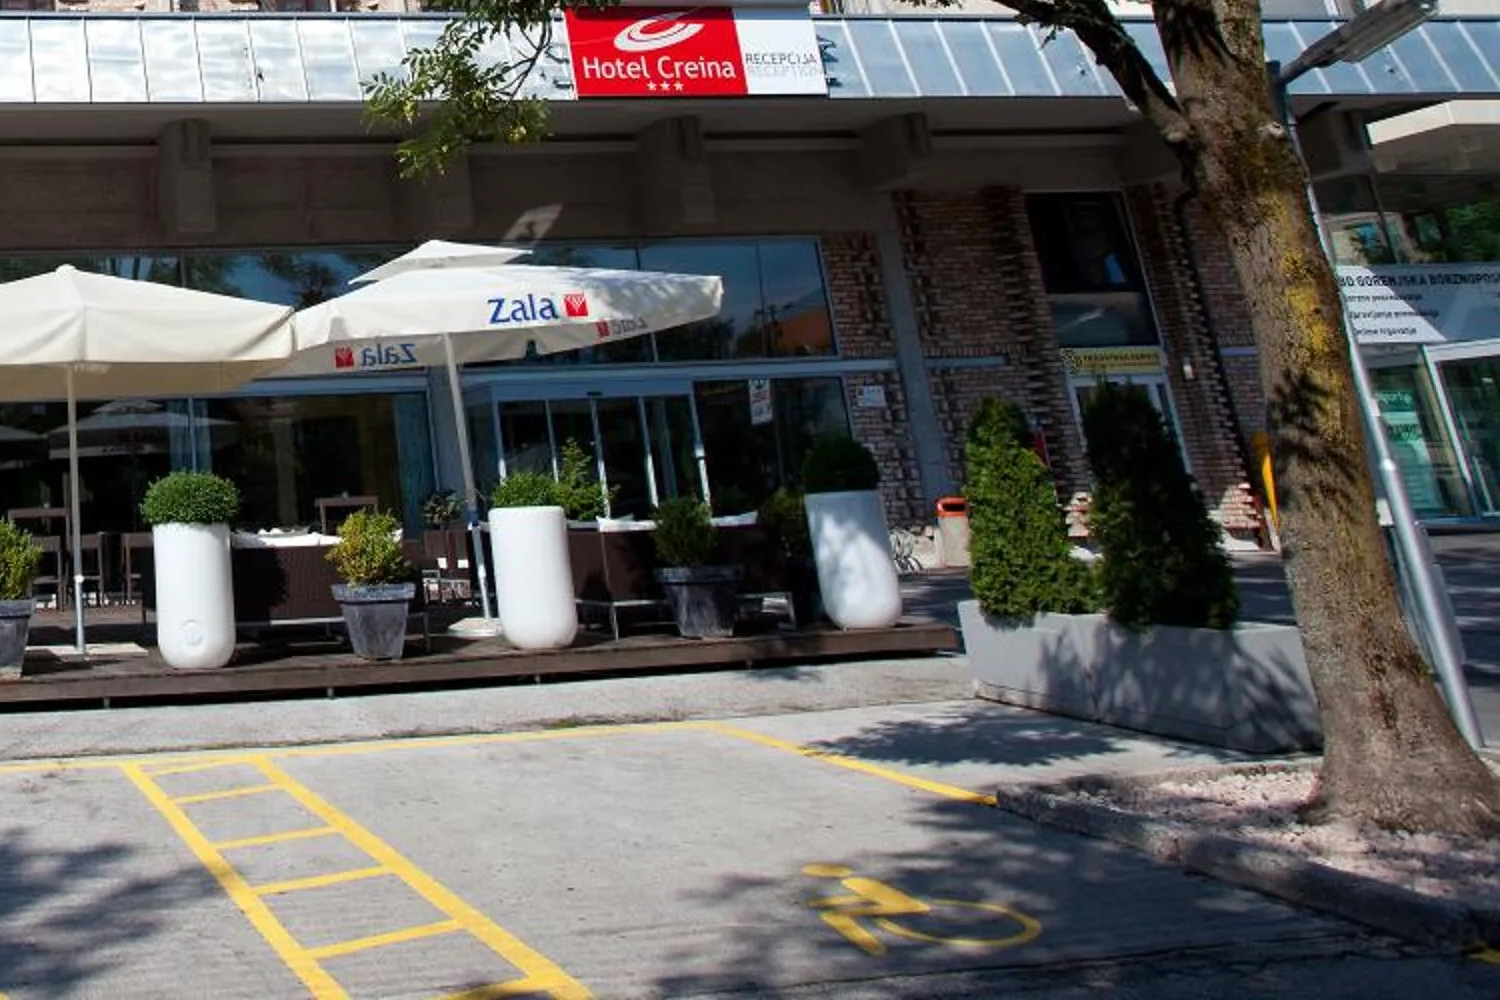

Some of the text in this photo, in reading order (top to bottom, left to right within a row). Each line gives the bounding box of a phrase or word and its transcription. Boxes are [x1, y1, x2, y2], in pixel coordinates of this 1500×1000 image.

[582, 55, 736, 79] Hotel Creina
[745, 52, 817, 65] RECEPCIJA
[488, 294, 559, 325] Zala
